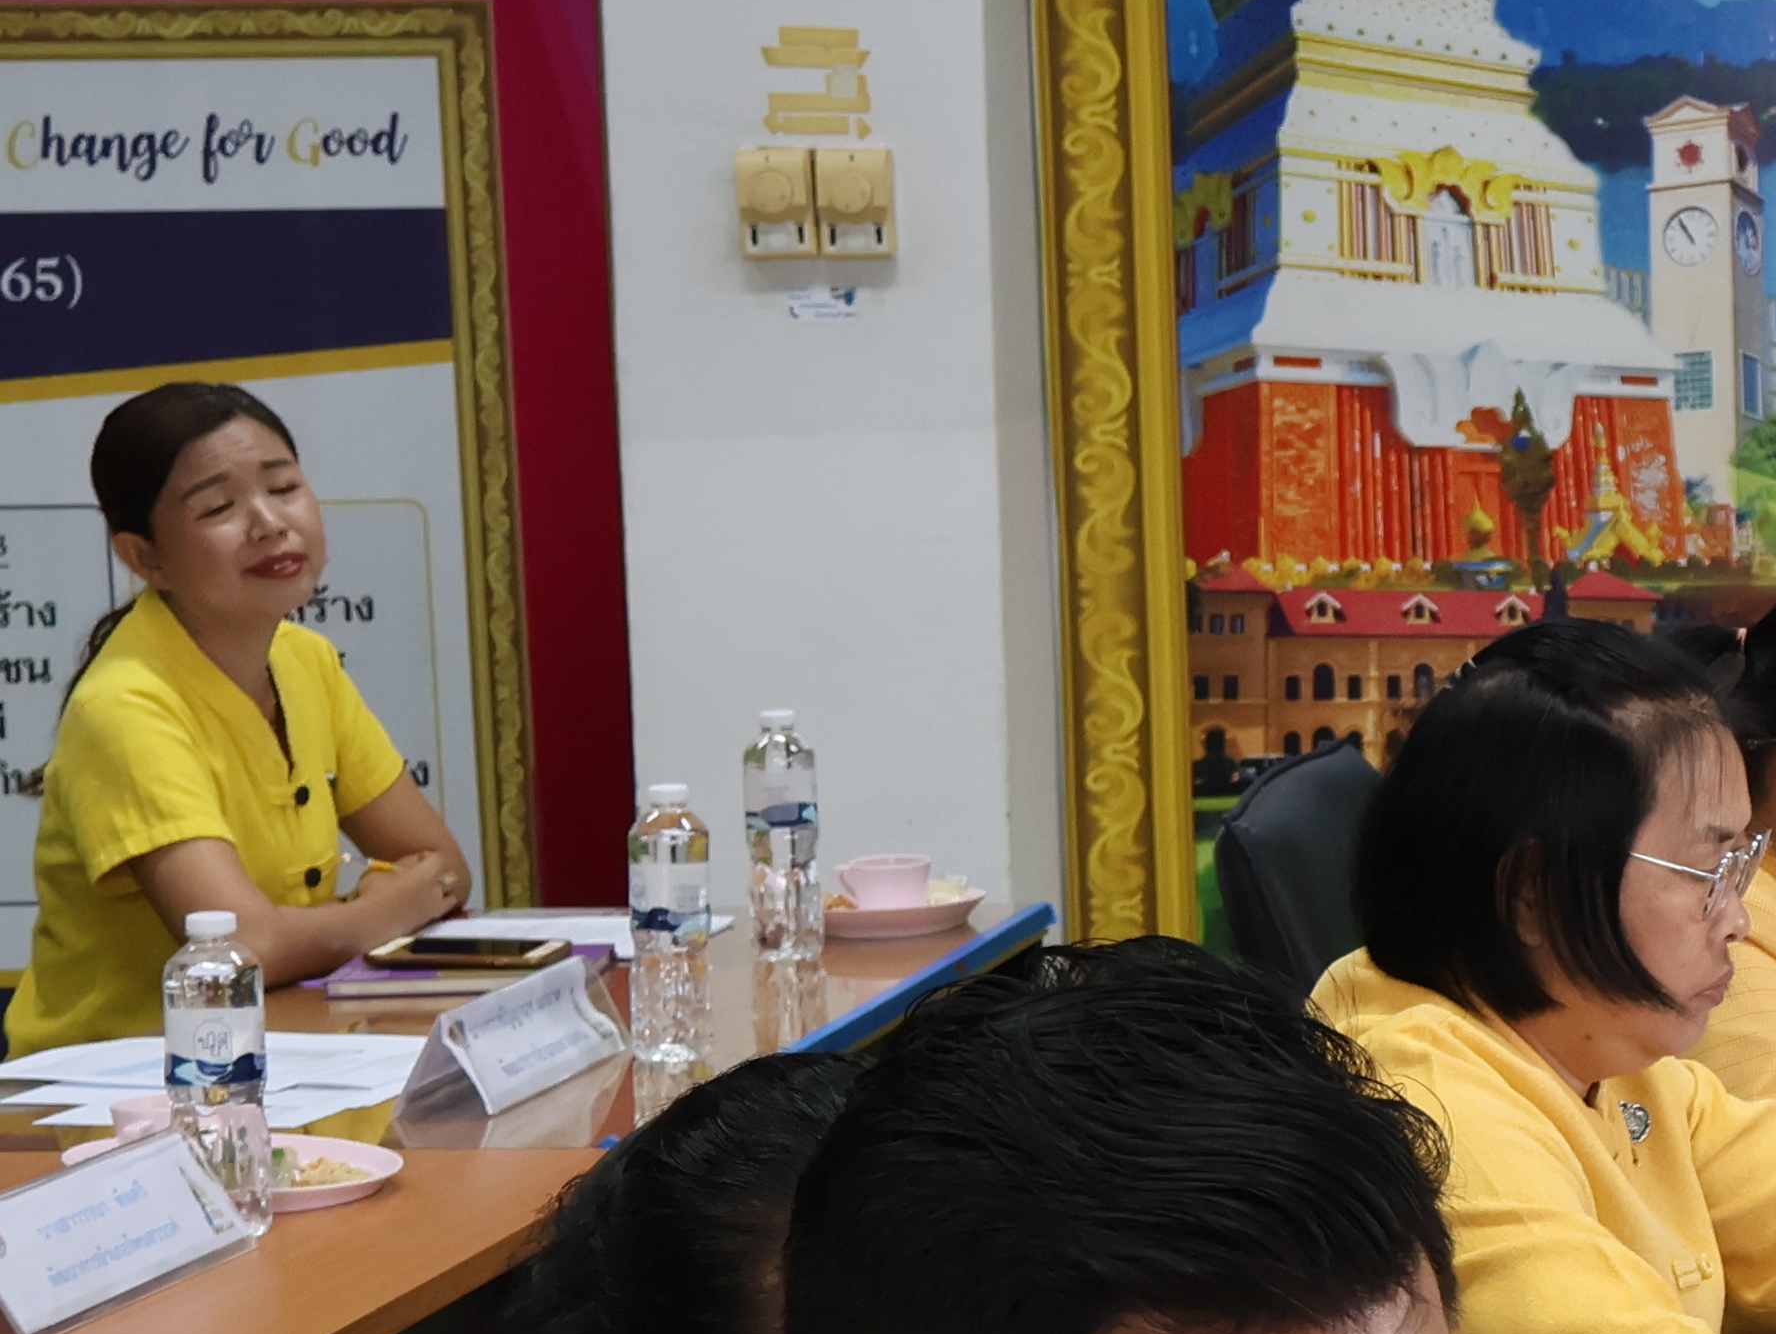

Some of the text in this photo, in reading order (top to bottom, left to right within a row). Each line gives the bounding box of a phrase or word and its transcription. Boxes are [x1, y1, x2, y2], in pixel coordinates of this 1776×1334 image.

[6, 111, 408, 186] Change for Good
